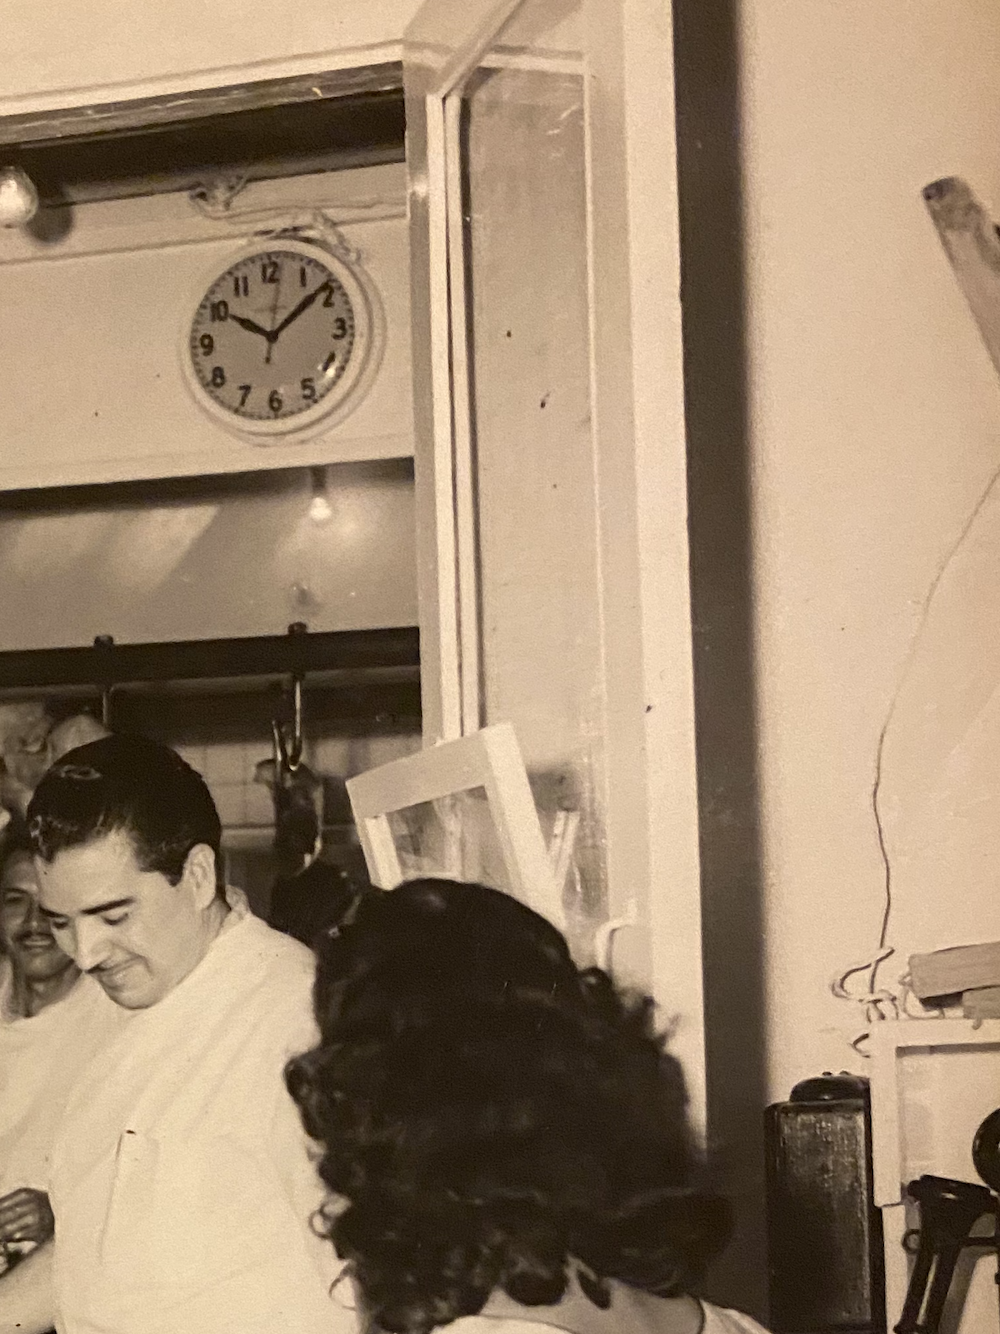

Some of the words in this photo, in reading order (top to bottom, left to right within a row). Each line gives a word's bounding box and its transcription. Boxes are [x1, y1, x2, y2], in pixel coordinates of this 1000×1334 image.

[261, 261, 279, 284] 12
[301, 266, 307, 287] 1
[233, 276, 249, 297] 11
[322, 284, 335, 308] 2
[210, 300, 229, 322] 10
[332, 317, 347, 340] 3
[200, 333, 214, 356] 9
[212, 366, 226, 388] 8
[238, 385, 251, 407] 7
[301, 377, 316, 400] 5
[269, 390, 283, 412] 6
